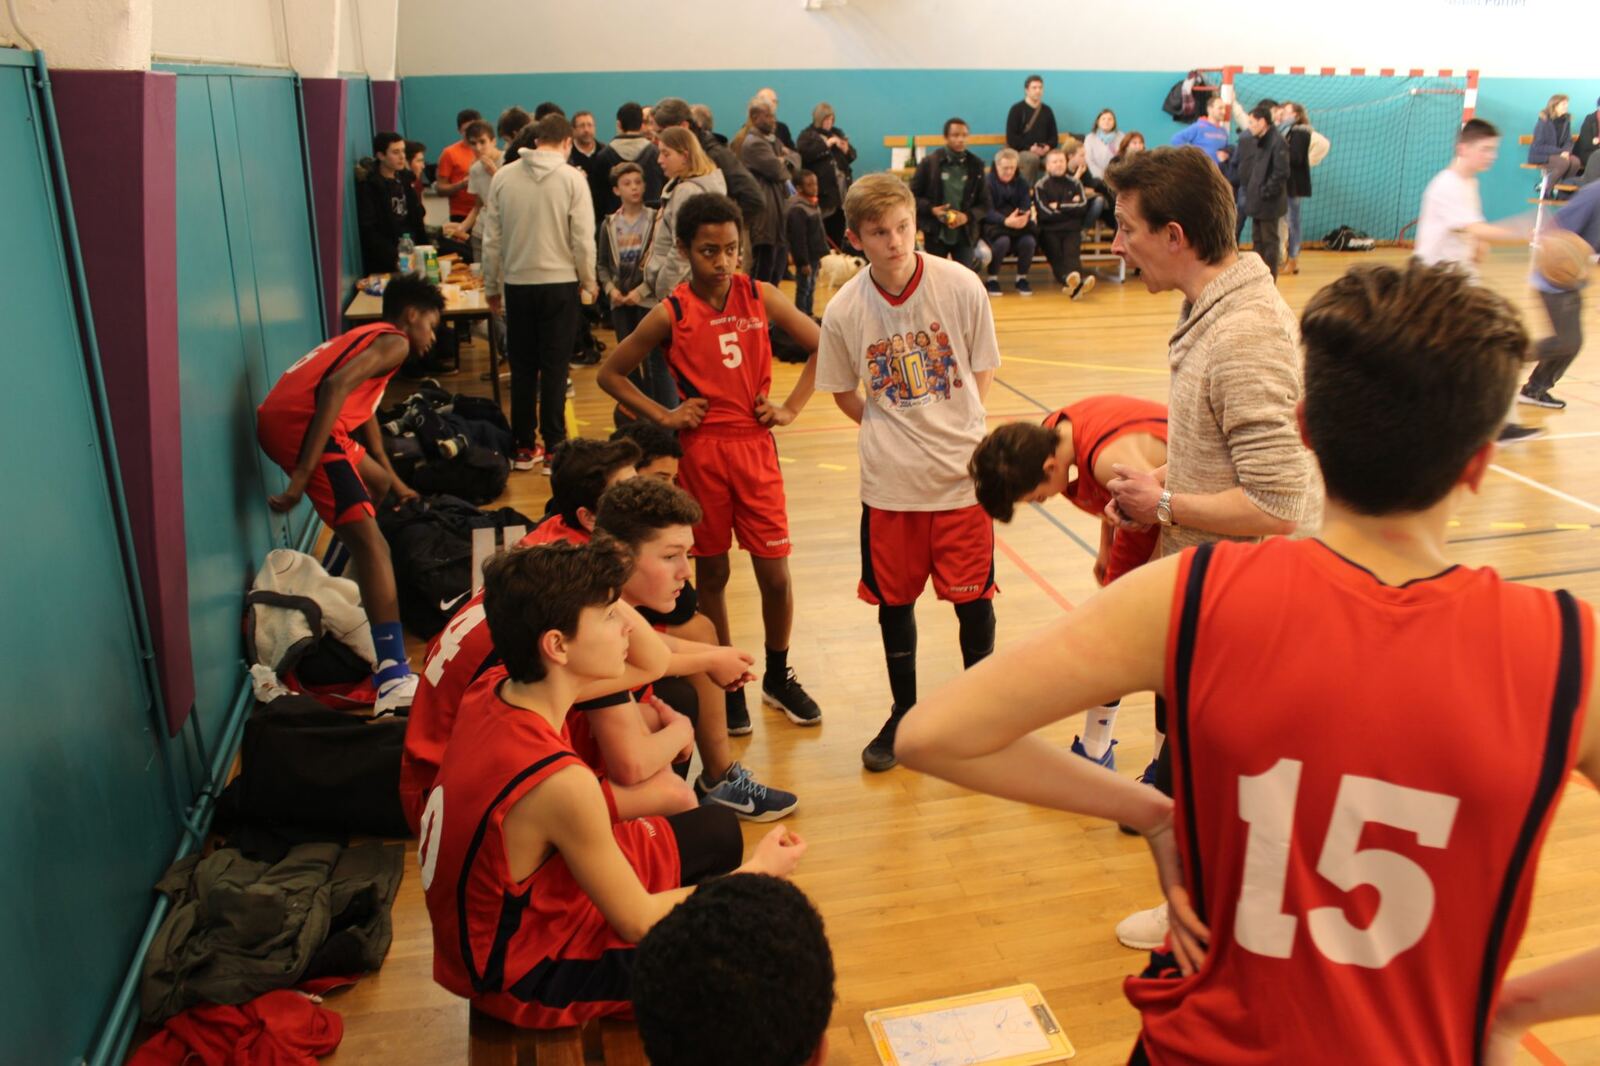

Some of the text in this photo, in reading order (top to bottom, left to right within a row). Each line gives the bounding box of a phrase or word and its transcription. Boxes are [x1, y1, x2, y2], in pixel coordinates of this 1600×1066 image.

[718, 331, 743, 369] 5
[424, 603, 486, 688] 4
[1234, 757, 1460, 969] 15
